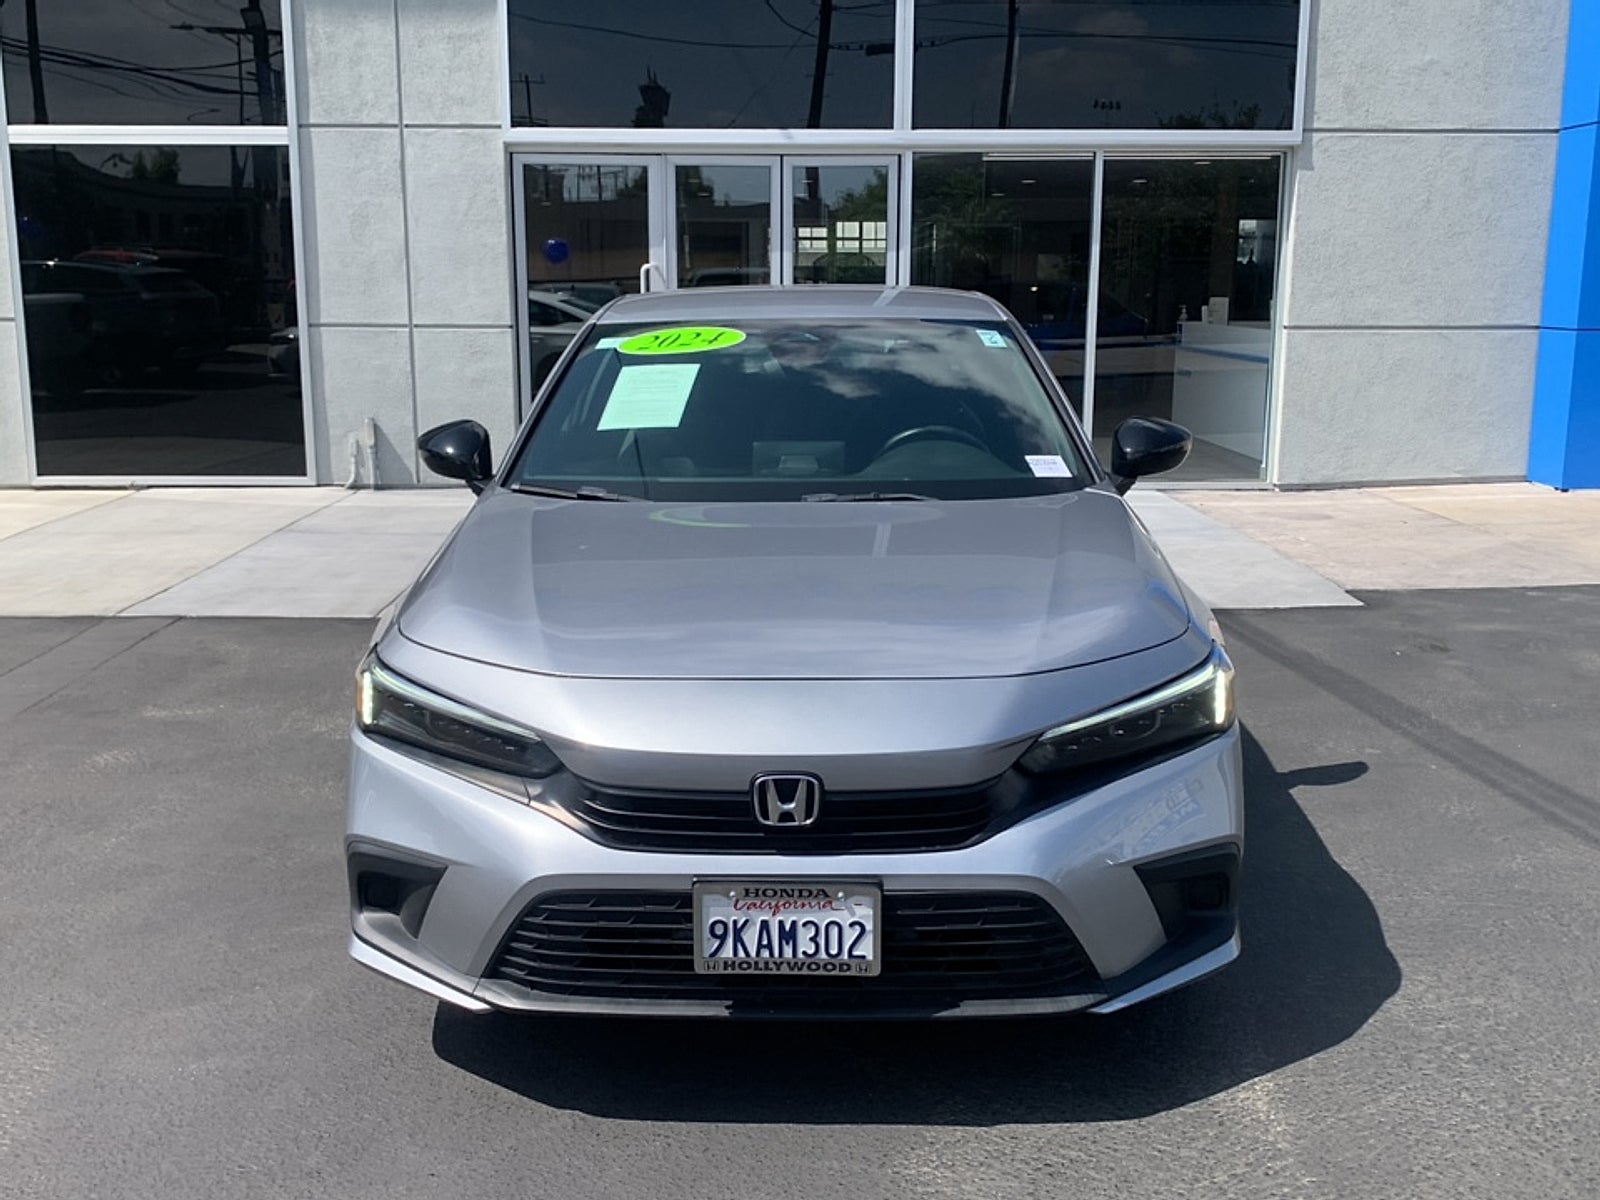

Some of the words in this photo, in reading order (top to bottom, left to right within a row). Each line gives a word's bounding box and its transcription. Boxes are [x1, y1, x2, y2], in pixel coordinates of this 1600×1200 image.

[636, 331, 728, 350] 2024
[743, 888, 831, 899] HONDA
[708, 918, 867, 961] 9KAM302
[723, 960, 853, 973] HOLLYWOOD
